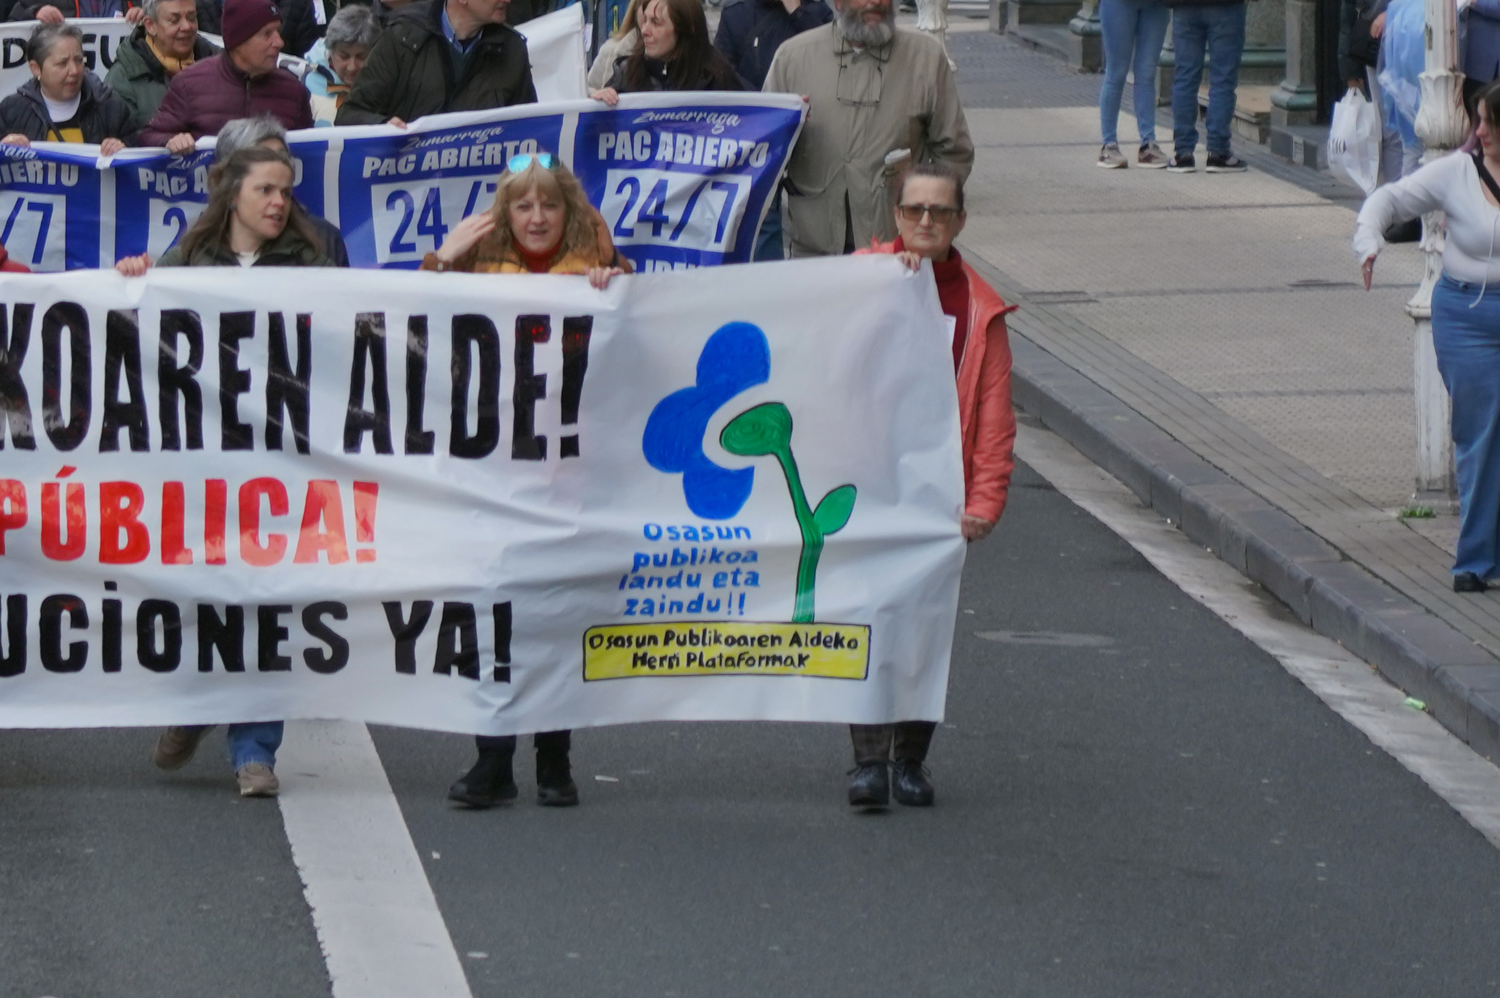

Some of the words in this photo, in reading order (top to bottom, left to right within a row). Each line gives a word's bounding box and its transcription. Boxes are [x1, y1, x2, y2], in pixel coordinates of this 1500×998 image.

[632, 111, 741, 135] Zumarraga
[400, 125, 504, 151] Zumarraga
[598, 130, 651, 162] PAC
[654, 132, 770, 168] ABIERTO
[362, 153, 416, 178] PAC
[421, 138, 538, 172] ABIERTO
[138, 167, 188, 198] PAC
[613, 176, 740, 244] 24/7
[0, 197, 54, 264] /7
[343, 312, 594, 461] ALDE!
[643, 522, 752, 542] Osasun
[631, 547, 759, 573] publikoa
[618, 569, 701, 591] landu
[712, 568, 760, 588] eta
[623, 591, 746, 617] zaindu!!
[381, 600, 513, 683] YA!
[588, 630, 659, 650] Osasun
[663, 629, 783, 649] Publikoaren
[788, 630, 859, 650] Aldeko
[632, 652, 681, 670] Herri
